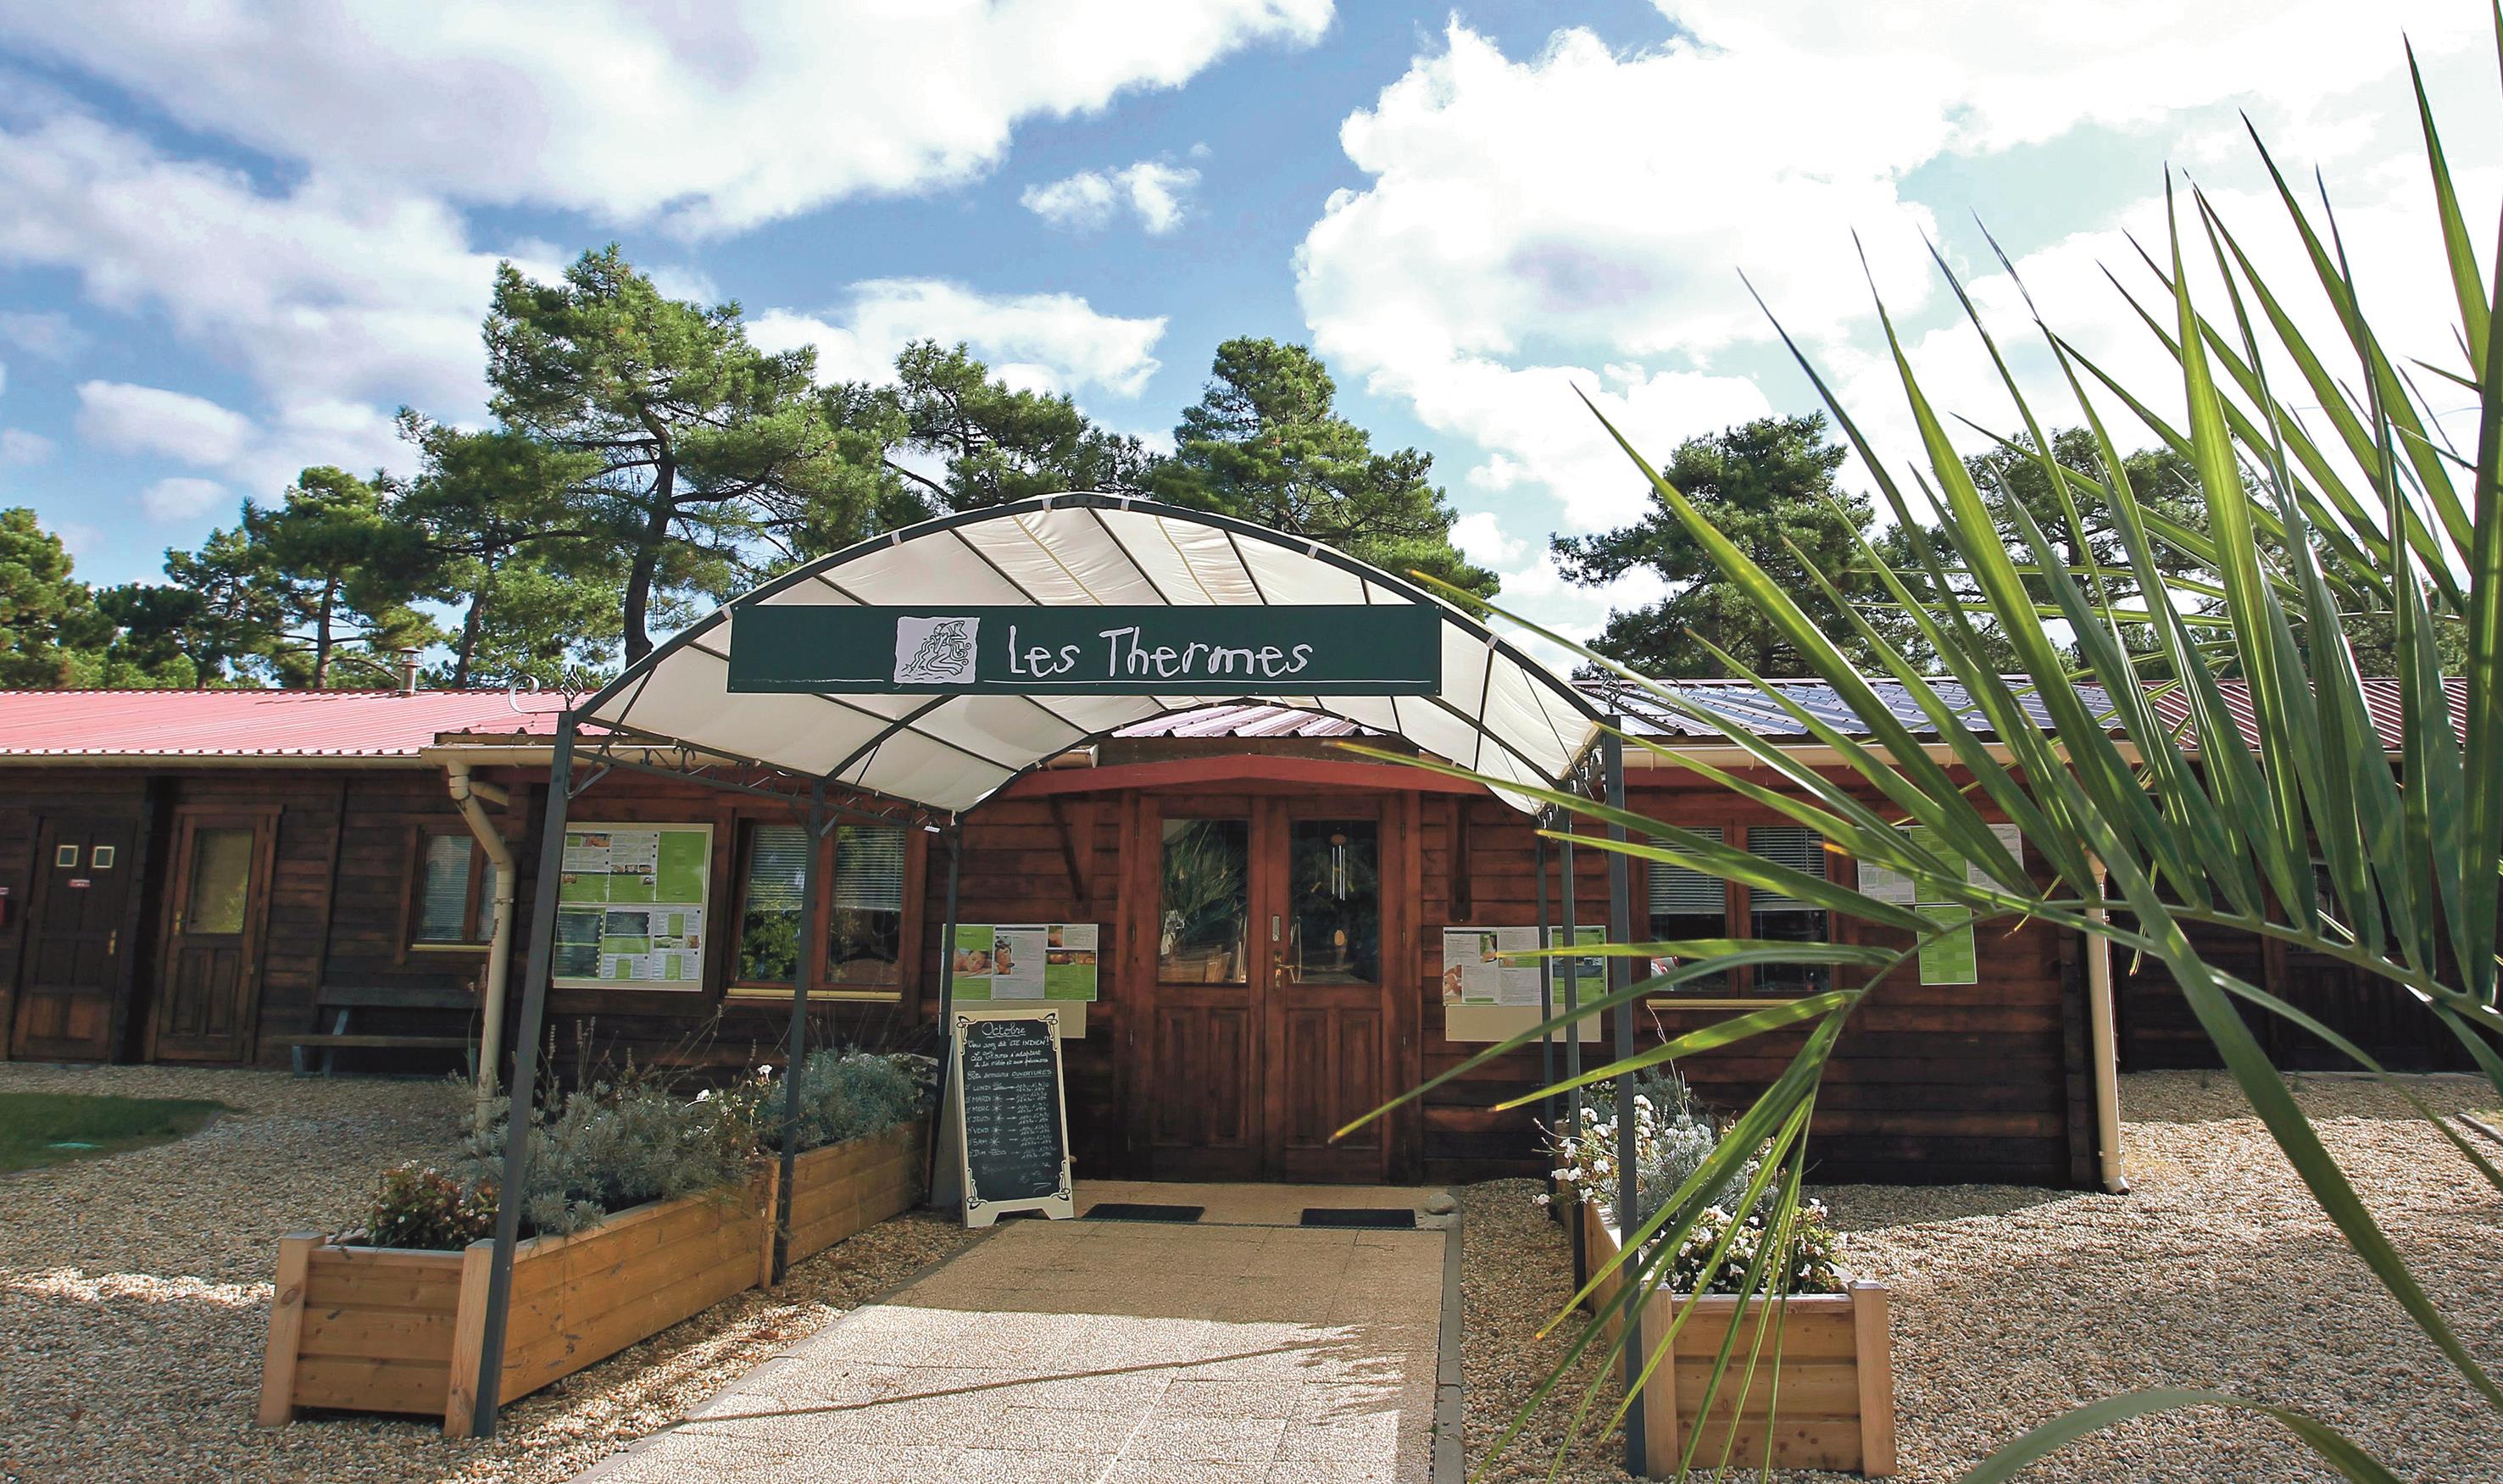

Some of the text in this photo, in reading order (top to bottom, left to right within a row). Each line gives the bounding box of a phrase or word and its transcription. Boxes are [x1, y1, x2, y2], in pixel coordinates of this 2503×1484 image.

[1008, 625, 1314, 678] Les Thermes
[982, 1022, 1026, 1036] Octobre
